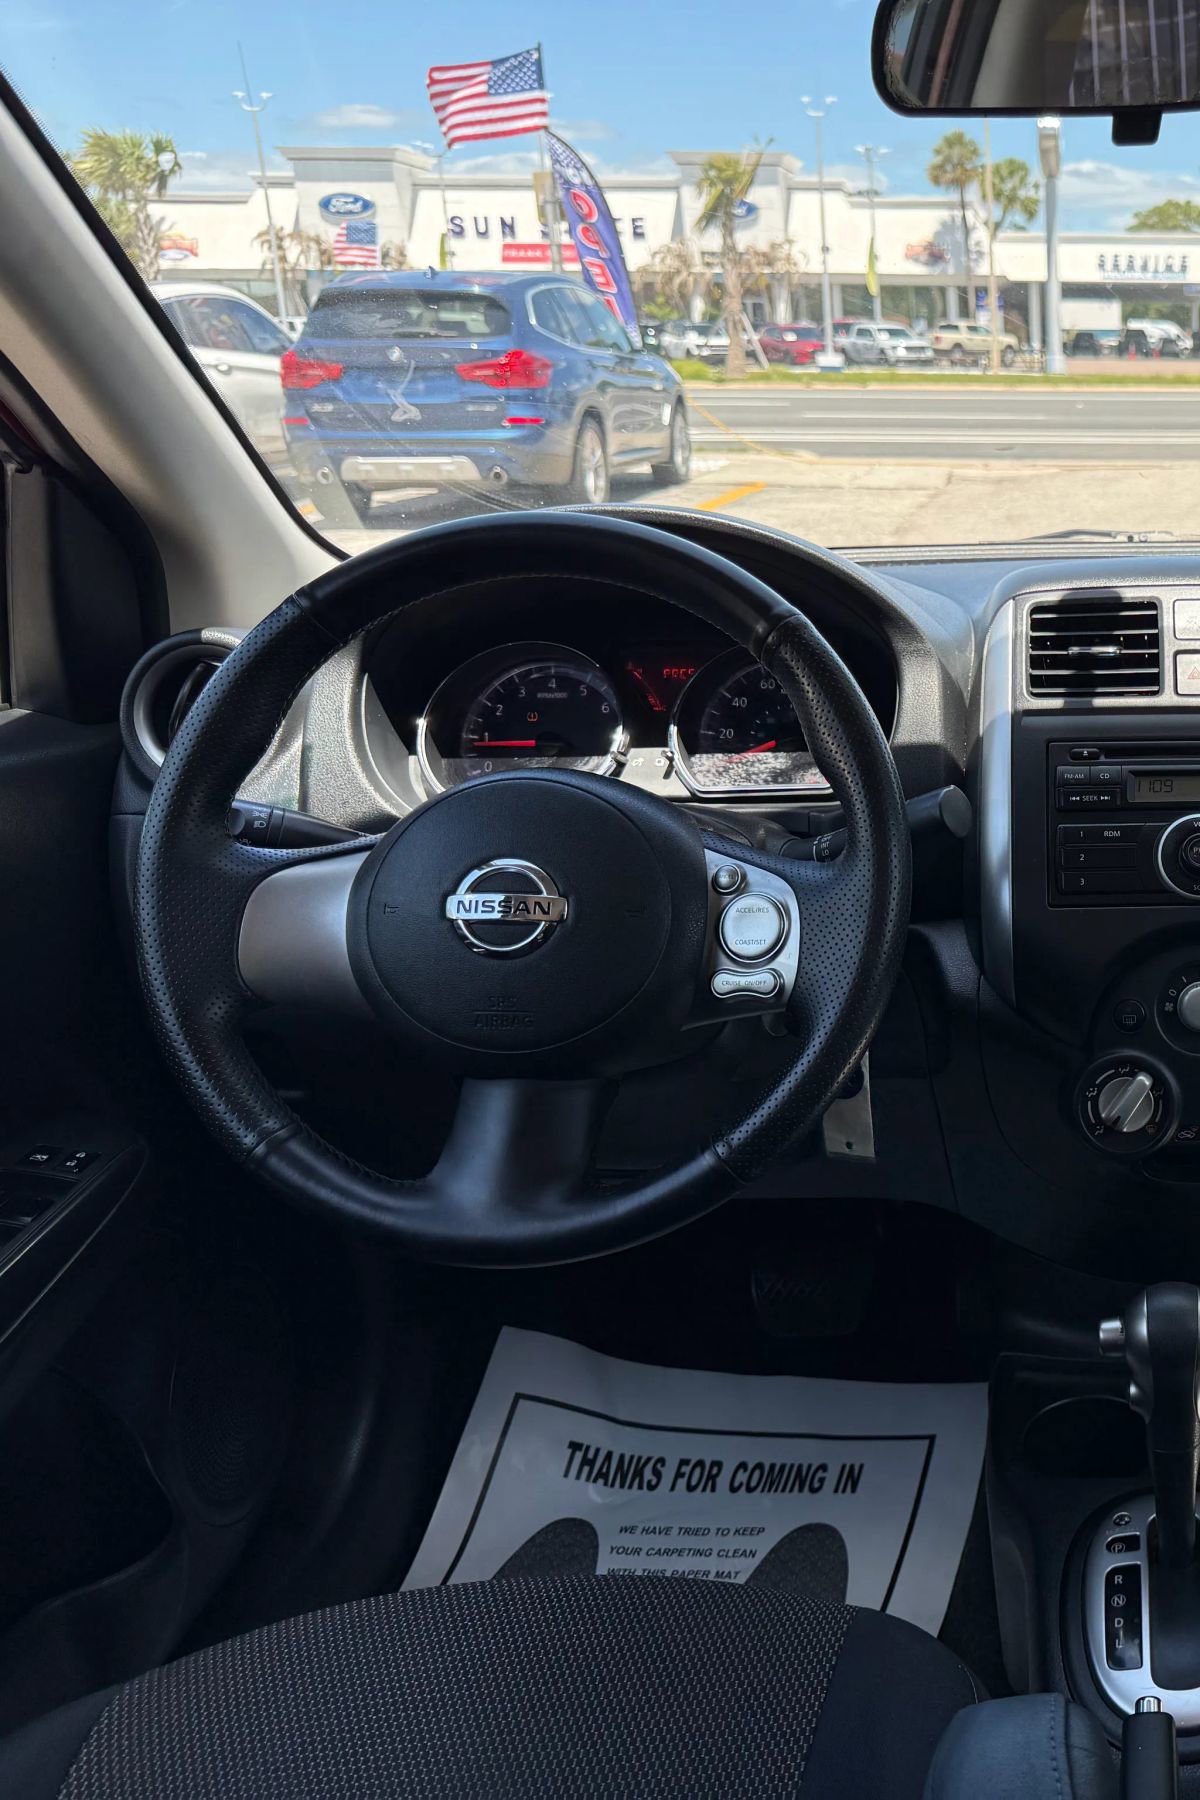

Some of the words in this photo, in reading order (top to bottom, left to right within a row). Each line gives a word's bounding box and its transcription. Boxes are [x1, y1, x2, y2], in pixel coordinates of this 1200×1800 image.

[449, 215, 516, 239] SUN
[1082, 794, 1099, 802] SEEK
[1103, 829, 1121, 837] RDM
[456, 899, 551, 916] NISSAN
[562, 1440, 667, 1492] THANKS
[669, 1458, 724, 1493] FOR
[728, 1460, 829, 1494] COMING
[833, 1463, 865, 1494] IN
[618, 1525, 639, 1535] WE
[640, 1526, 674, 1536] HAVE
[676, 1526, 711, 1537] TRIED
[714, 1527, 730, 1537] TO
[733, 1527, 766, 1537] KEEP
[609, 1545, 642, 1556] YOUR
[645, 1546, 713, 1558] CARPETING
[716, 1549, 758, 1559] CLEAN
[671, 1569, 711, 1579] PAPER
[713, 1570, 741, 1580] MAT
[1114, 1575, 1123, 1585] R
[1114, 1618, 1124, 1628] D
